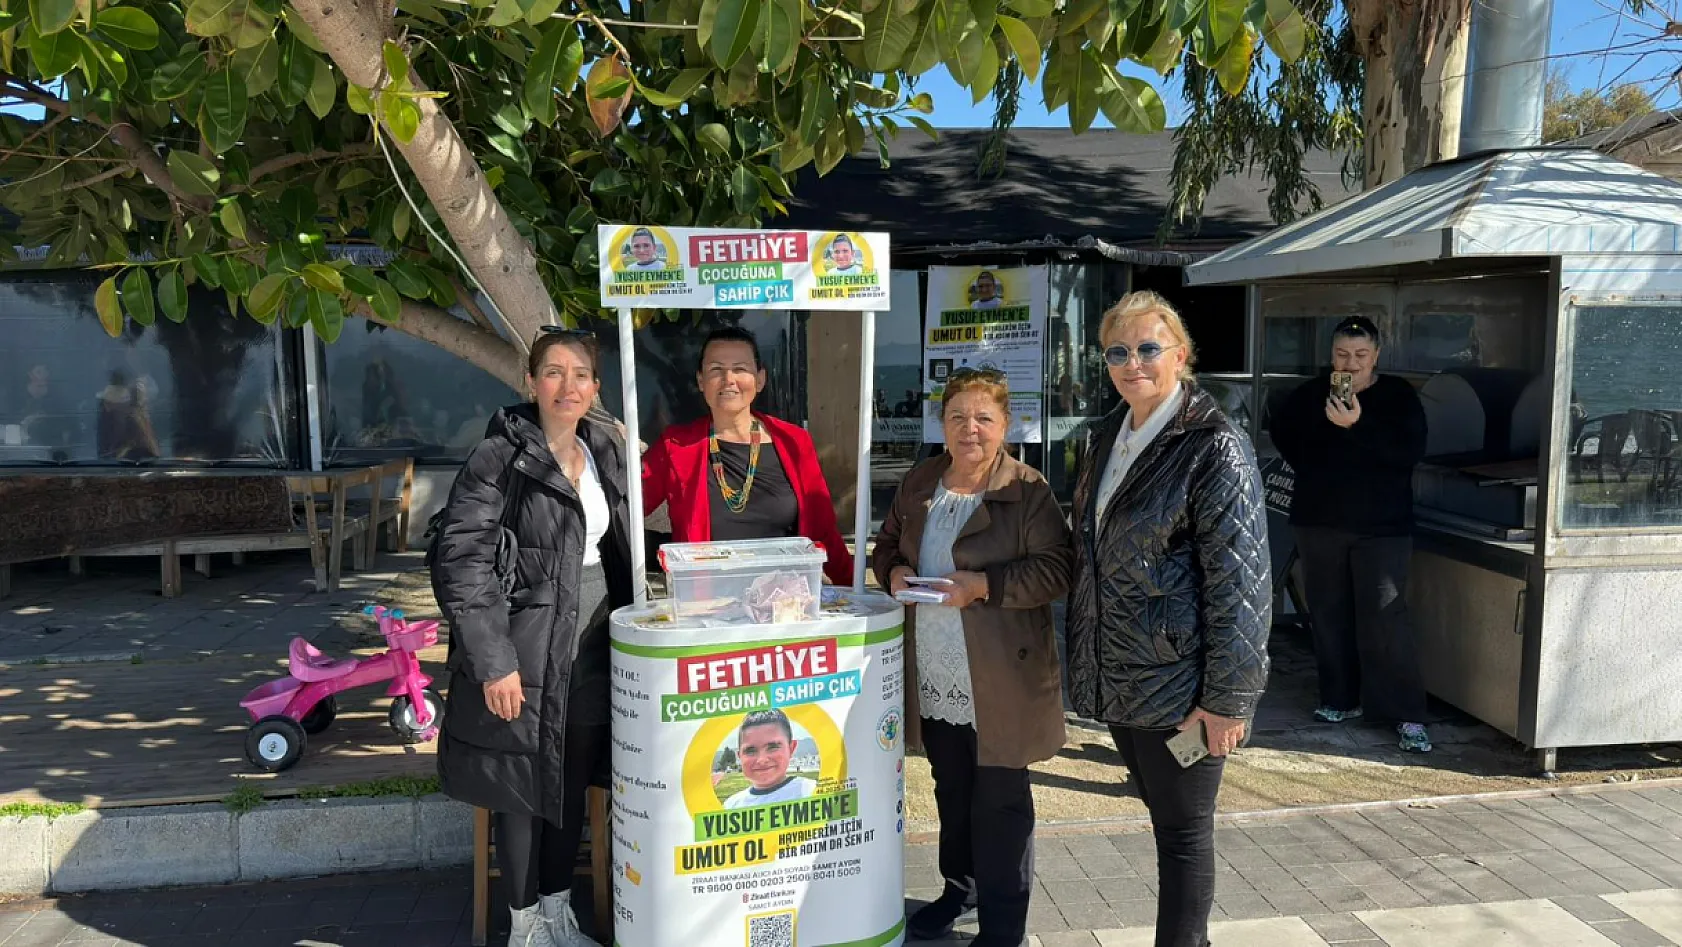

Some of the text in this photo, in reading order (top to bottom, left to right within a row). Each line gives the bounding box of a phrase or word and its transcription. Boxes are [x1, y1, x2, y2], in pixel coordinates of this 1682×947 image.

[700, 232, 798, 262] FETHİYE
[617, 271, 644, 282] YUSUF
[702, 265, 777, 285] ÇOCUĞUNA
[819, 275, 842, 287] YUSUF
[609, 285, 633, 296] UMUT
[635, 283, 646, 294] OL
[718, 283, 790, 303] SAHİP ÇIK
[811, 289, 833, 299] UMUT
[834, 288, 844, 298] OL
[945, 311, 977, 325] YUSUF
[933, 327, 978, 342] UMUT OL
[688, 645, 828, 693] FETHİYE
[666, 675, 857, 722] ÇOCUĞUNA SAHİP ÇIK
[703, 794, 851, 838] YUSUF EYMEN'E
[778, 818, 863, 846] HAYALLERİM İÇİN
[778, 844, 797, 860] BİR
[800, 840, 827, 855] ADIM
[829, 837, 842, 850] DA
[864, 828, 875, 843] AT
[682, 839, 768, 871] UMUT OL
[812, 862, 837, 871] SAMET
[838, 858, 861, 868] AYDIN
[692, 885, 704, 894] TR
[735, 879, 758, 890] 0100
[760, 876, 784, 887] 0203
[813, 869, 835, 880] 8041
[837, 866, 861, 878] 5009
